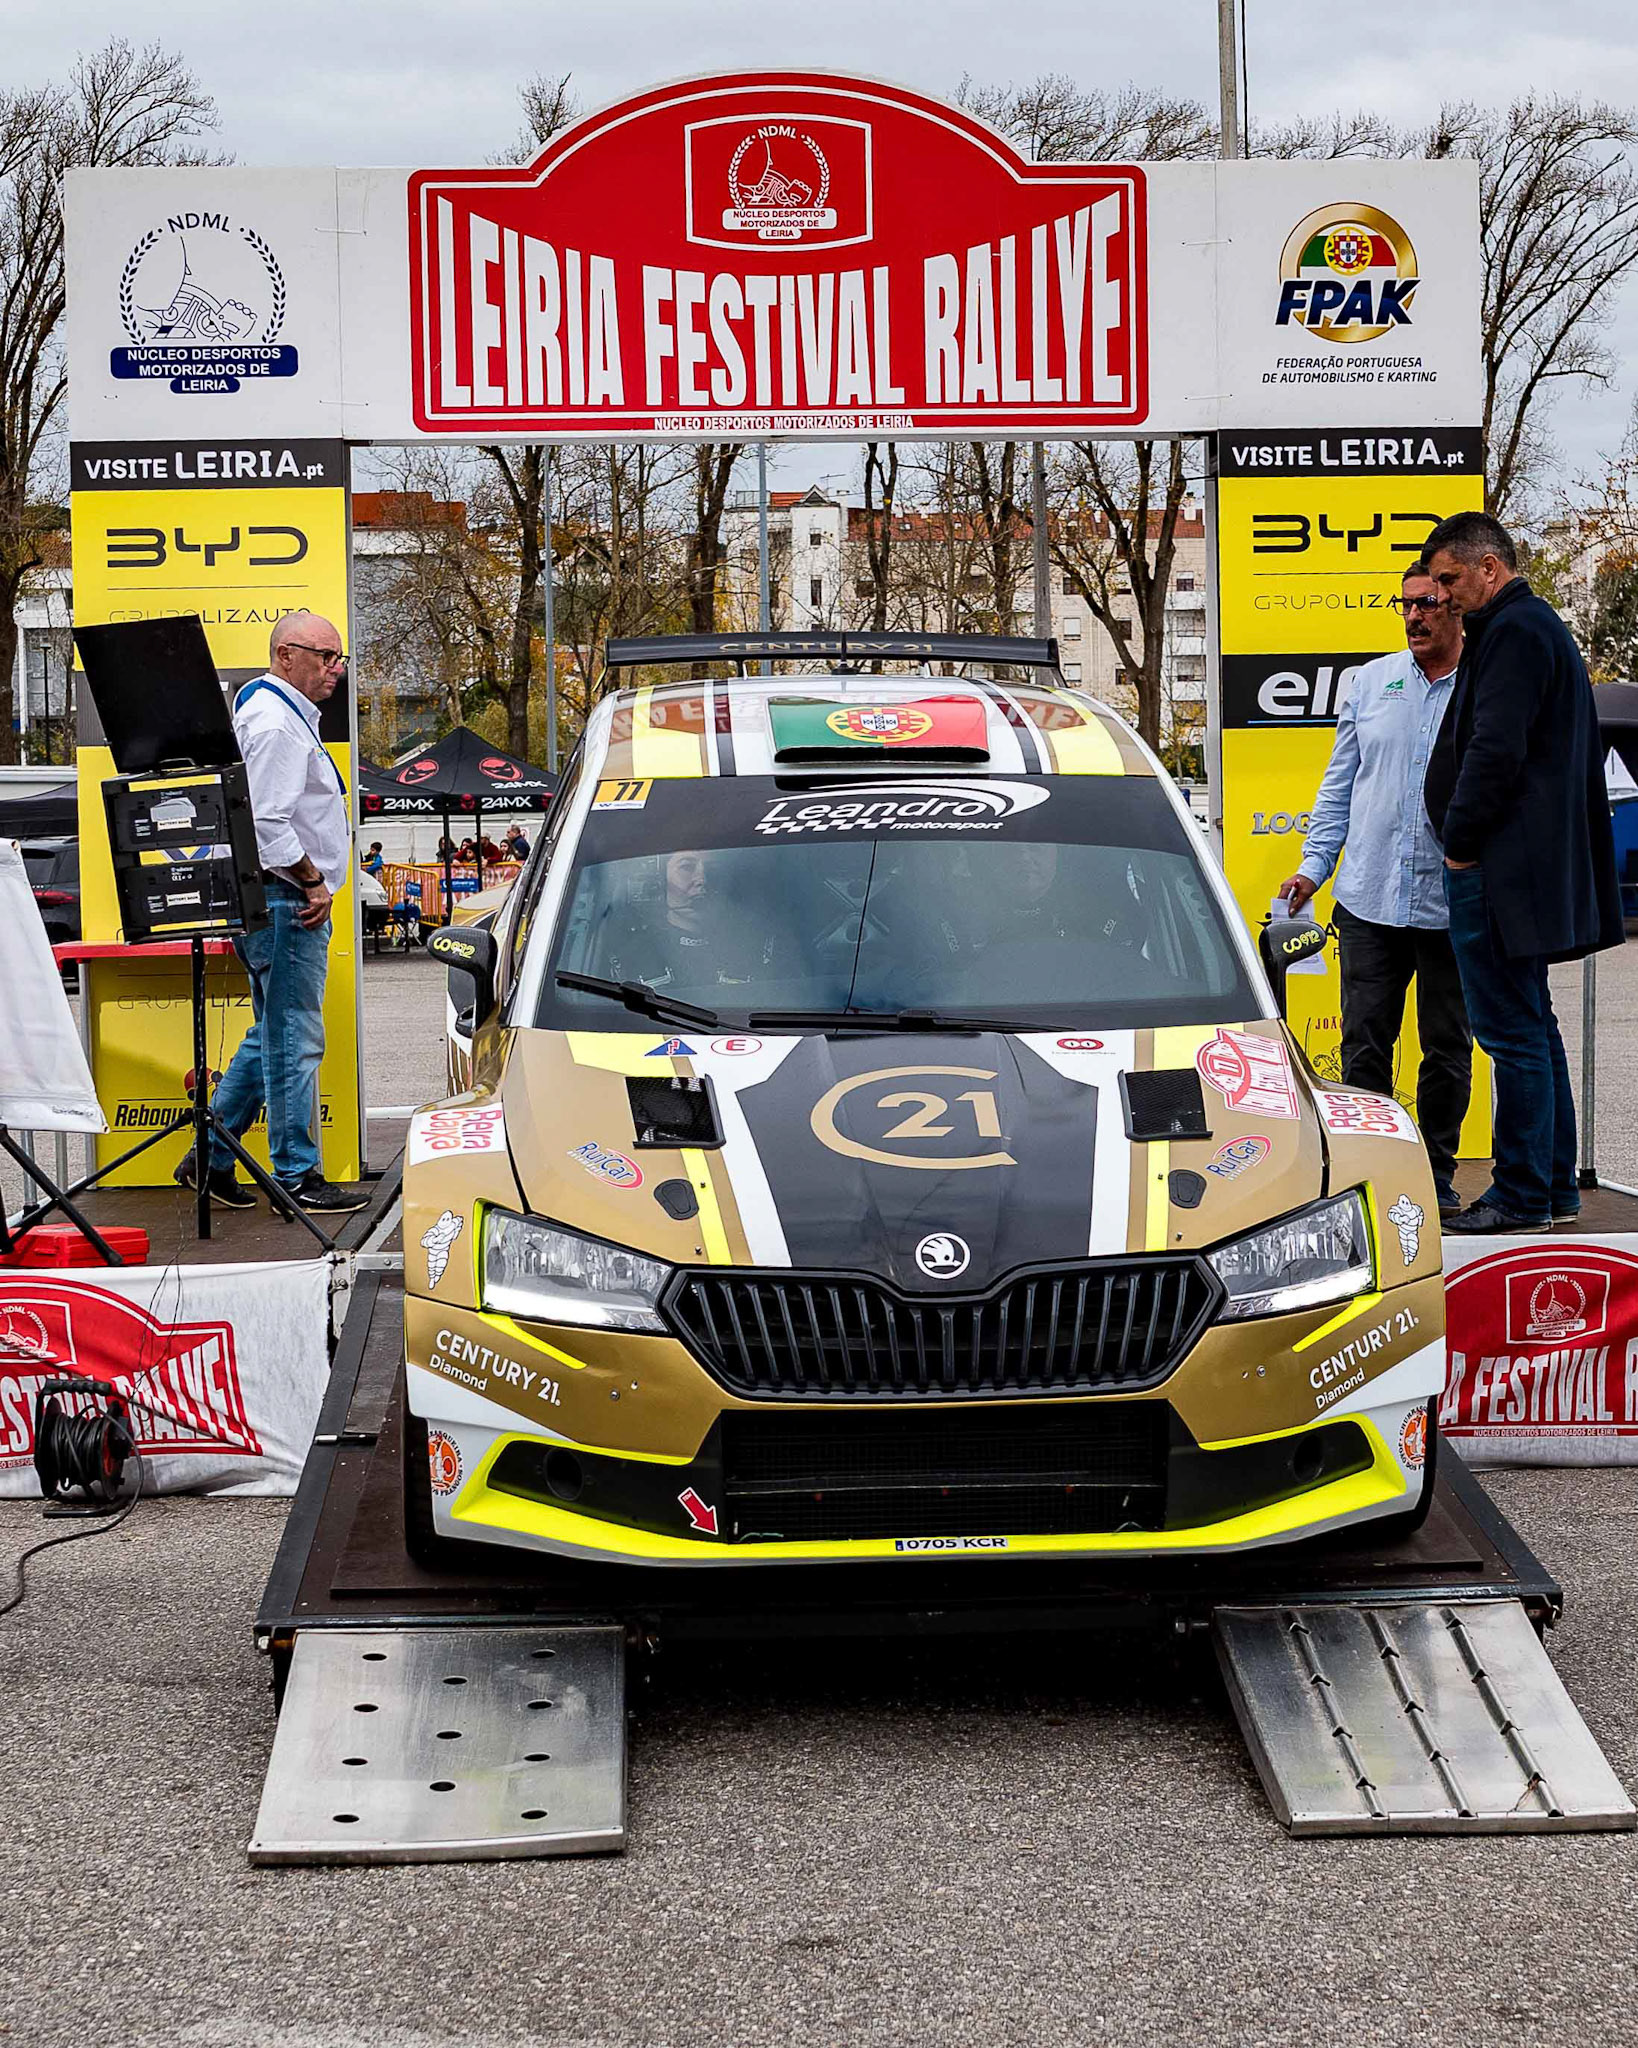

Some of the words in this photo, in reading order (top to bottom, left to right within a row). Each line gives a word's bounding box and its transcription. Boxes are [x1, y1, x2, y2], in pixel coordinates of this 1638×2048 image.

[758, 125, 796, 139] NDML
[167, 212, 230, 233] NDML
[772, 210, 826, 218] DESPORTOS
[740, 220, 804, 228] MOTORIZADOS
[437, 194, 624, 408] LEIRIA
[642, 265, 905, 407] FESTIVAL
[924, 190, 1122, 405] RALLYE
[1275, 279, 1421, 326] FPAK
[128, 348, 188, 361] NÚCLEO
[192, 348, 281, 360] DESPORTOS
[1277, 356, 1343, 370] FEDERAÇÃO
[1346, 357, 1422, 368] PORTUGUESA
[139, 364, 246, 376] MOTORIZADOS
[250, 363, 270, 374] DE
[1262, 373, 1277, 383] DE
[1280, 372, 1374, 383] AUTOMOBILISMO
[1378, 372, 1384, 382] E
[1388, 372, 1437, 382] KARTING
[182, 379, 229, 392] LEIRIA
[704, 417, 770, 429] DESPORTOS
[774, 416, 855, 429] MOTORIZADOS
[859, 416, 874, 428] DE
[876, 415, 914, 428] LEIRIA
[1232, 446, 1312, 466] VISITE
[1320, 438, 1464, 467] LEIRIA.pt
[84, 459, 168, 480] VISITE
[175, 450, 324, 480] LEIRIA.pt
[1253, 513, 1446, 553] BYD
[106, 526, 308, 568] BYD
[720, 643, 894, 652] CENTURY
[491, 780, 548, 790] 24MX
[384, 798, 435, 811] 24MX
[481, 796, 533, 809] 24MX
[762, 798, 987, 823] Leandro
[890, 818, 1004, 832] motorsport
[726, 1040, 746, 1051] E
[877, 1092, 1002, 1138] 21
[1352, 1097, 1399, 1132] baixa
[420, 1110, 480, 1150] baixa
[576, 1142, 634, 1180] RuiCar
[1206, 1140, 1260, 1177] RuiCar
[1546, 1274, 1568, 1283] NDML
[436, 1330, 538, 1391] CENTURY
[1309, 1320, 1393, 1389] CENTURY
[429, 1354, 488, 1392] Diamond
[1315, 1368, 1366, 1410] Diamond
[1471, 1346, 1613, 1423] FESTIVAL
[1501, 1428, 1539, 1437] DESPORTOS
[1540, 1428, 1586, 1436] MOTORIZADOS
[1587, 1428, 1595, 1436] DE
[906, 1539, 957, 1550] 0705
[963, 1538, 1006, 1548] KCR
